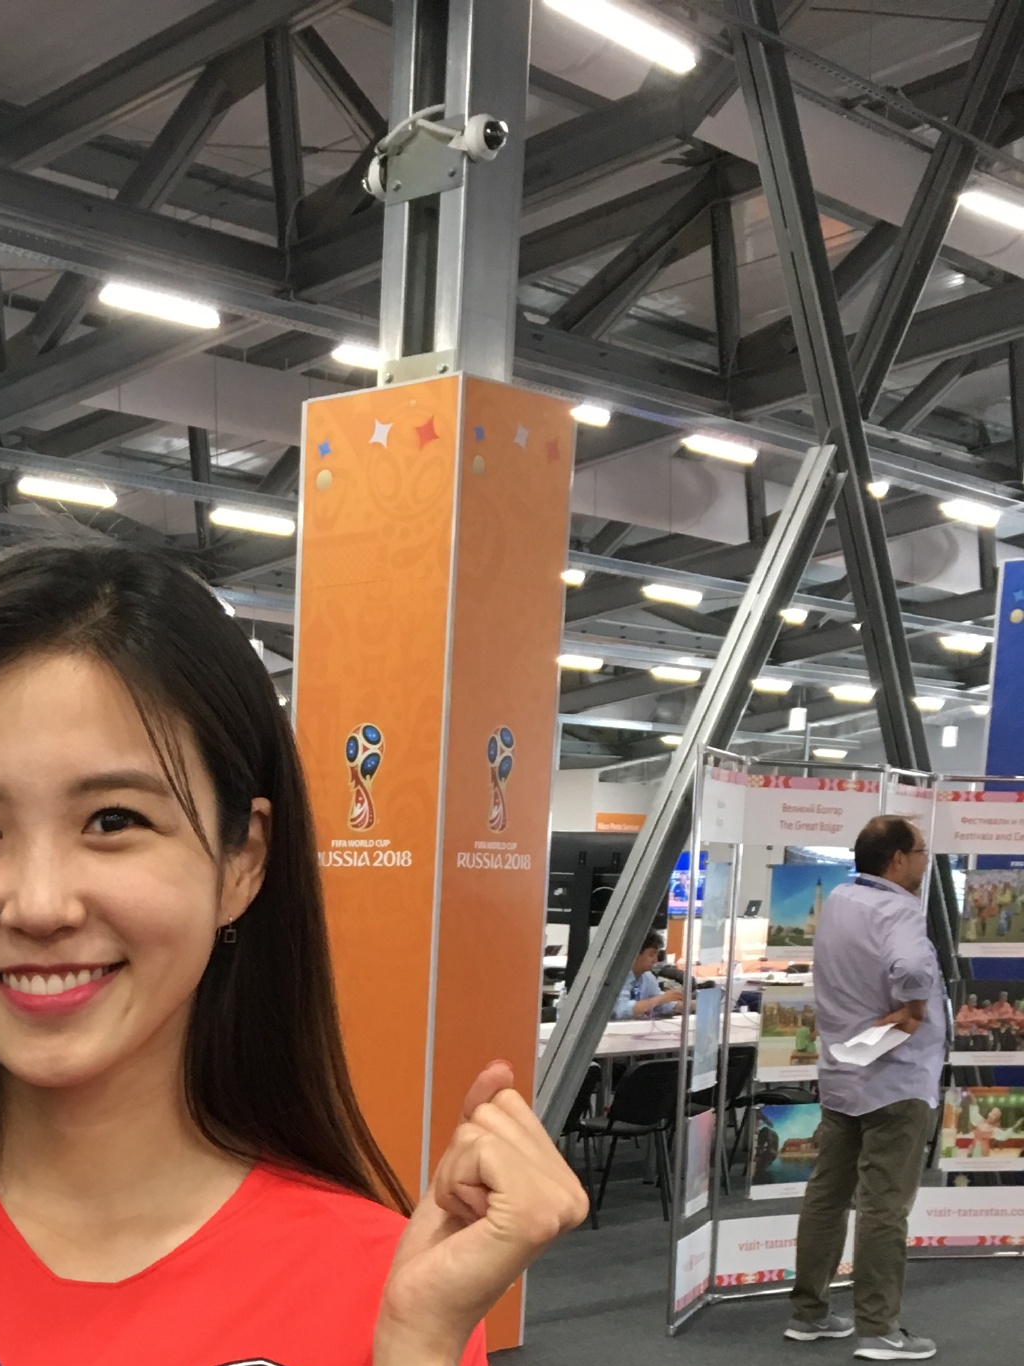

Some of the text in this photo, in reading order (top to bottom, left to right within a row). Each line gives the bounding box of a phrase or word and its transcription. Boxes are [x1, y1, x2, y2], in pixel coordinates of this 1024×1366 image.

[779, 820, 794, 830] The
[995, 832, 1012, 841] and
[331, 839, 391, 848] FIFA WORLD CUP
[372, 850, 412, 867] 2018
[457, 852, 531, 870] RUSSIA 2018
[925, 1207, 1024, 1218] visit-tatarstan.co
[738, 1238, 798, 1252] visit-tatarst
